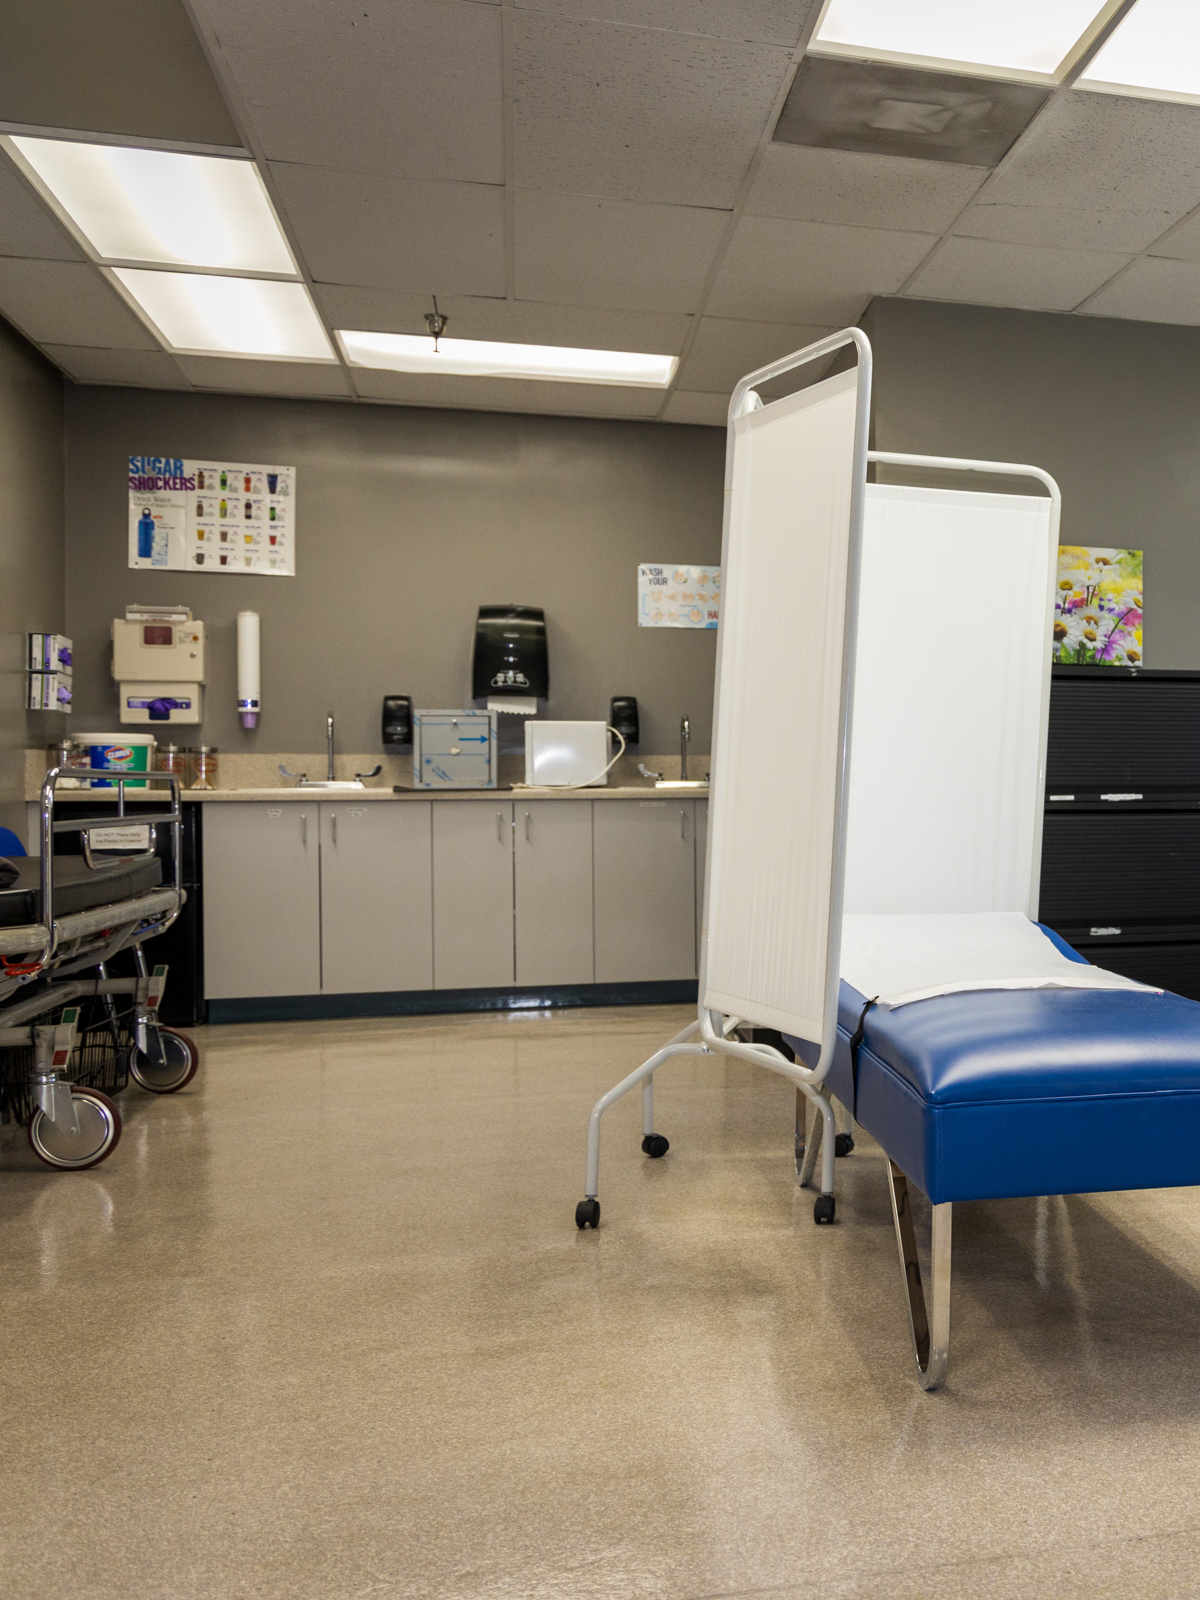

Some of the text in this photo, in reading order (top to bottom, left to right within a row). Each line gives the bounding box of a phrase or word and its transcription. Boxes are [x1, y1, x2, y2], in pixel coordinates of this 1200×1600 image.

[129, 456, 184, 477] SUGAR
[129, 476, 196, 491] SHOCKERS
[641, 568, 663, 577] WASH
[649, 577, 668, 585] YOUR
